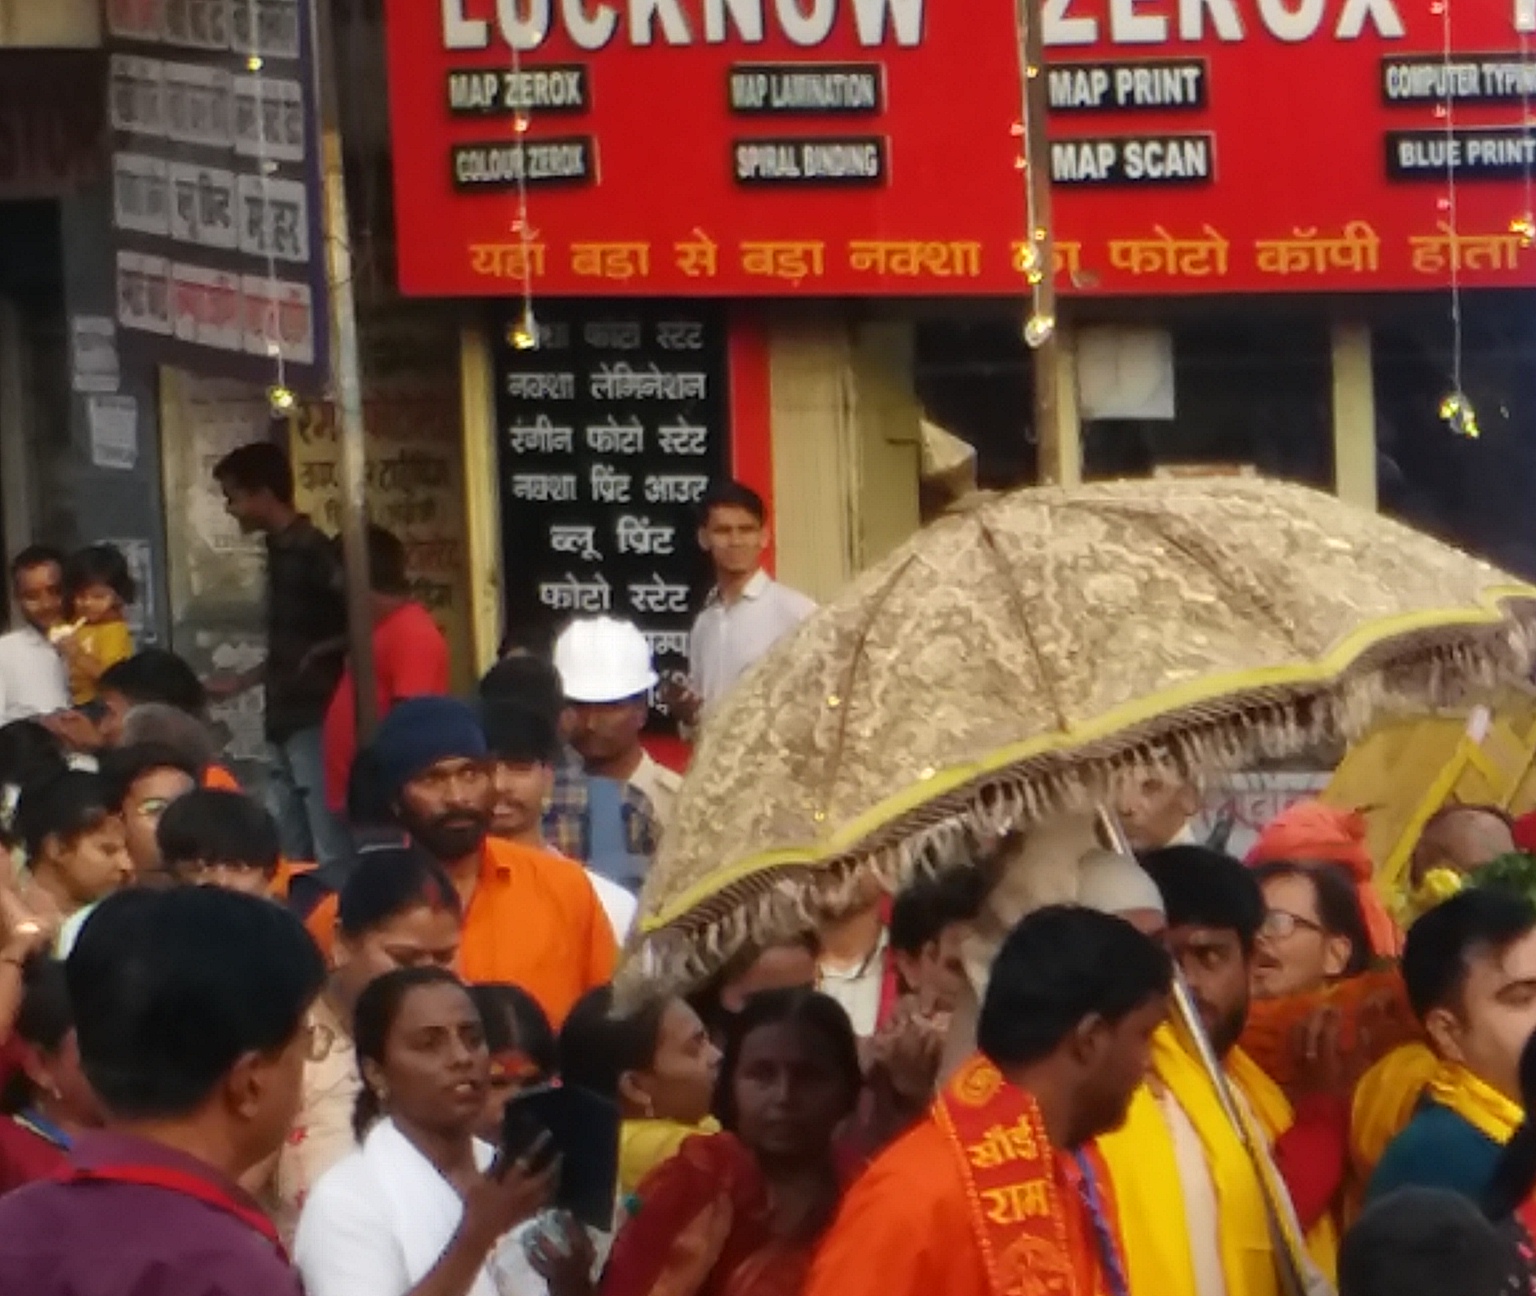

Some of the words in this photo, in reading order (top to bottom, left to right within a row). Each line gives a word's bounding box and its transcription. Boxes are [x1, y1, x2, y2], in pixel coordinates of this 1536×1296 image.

[444, 0, 923, 50] LUCKNOW
[450, 73, 498, 108] MAP
[504, 71, 582, 107] ZEROX
[732, 73, 768, 108] MAP
[771, 73, 875, 108] LAMINATION
[1048, 70, 1109, 107] MAP
[1116, 67, 1200, 105] PRINT
[1386, 63, 1480, 98] COMPUTER
[456, 148, 525, 182] COLOUR
[528, 144, 584, 178] ZEROX
[737, 145, 801, 179] SPIRAL
[804, 144, 878, 177] BINDING
[1052, 143, 1113, 182] MAP
[1123, 141, 1208, 179] SCAN
[1399, 141, 1461, 169] BLUE
[676, 227, 718, 277] से
[741, 239, 825, 285] बड़ा
[1109, 225, 1230, 276] फोटो
[1255, 221, 1380, 276] कॉपी
[586, 413, 644, 453] फोटो
[658, 413, 708, 455] स्टेट
[539, 572, 613, 611] फोटो
[628, 572, 690, 613] स्टेट
[980, 1179, 1051, 1225] राम
